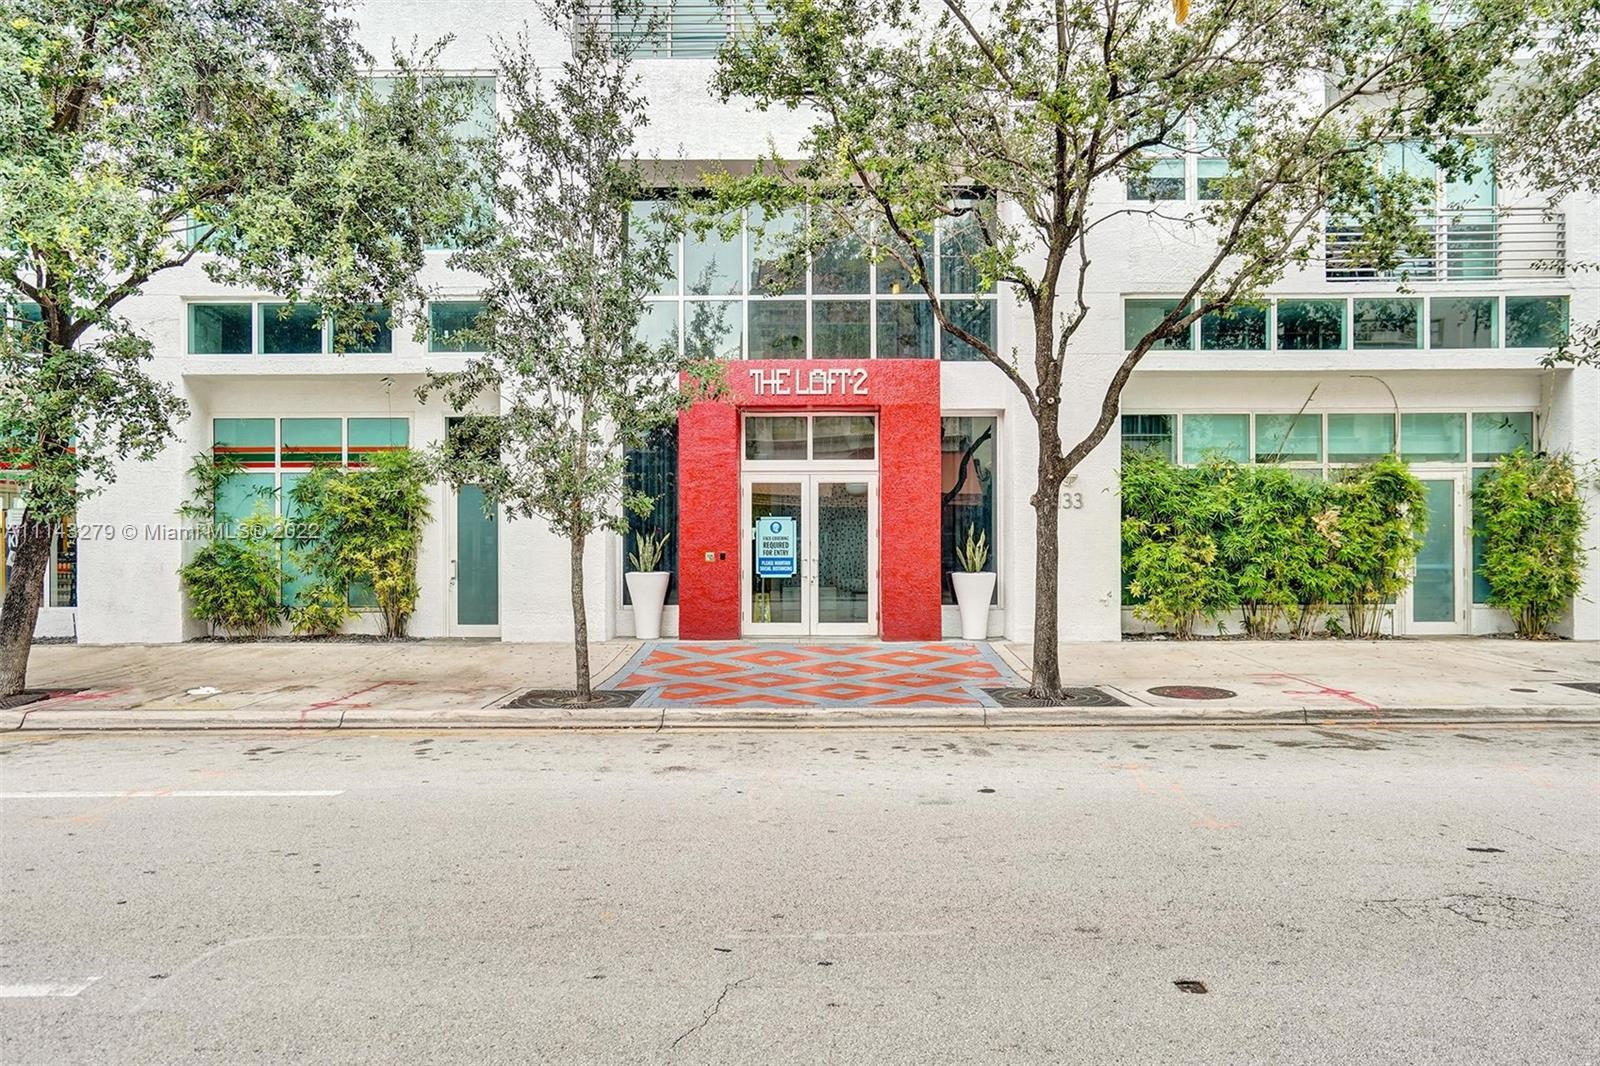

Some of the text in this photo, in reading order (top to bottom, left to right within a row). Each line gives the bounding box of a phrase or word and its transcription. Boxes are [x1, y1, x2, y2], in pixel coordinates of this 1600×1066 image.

[749, 368, 791, 395] THE
[1059, 492, 1083, 509] 33
[763, 541, 790, 549] REQUIRED
